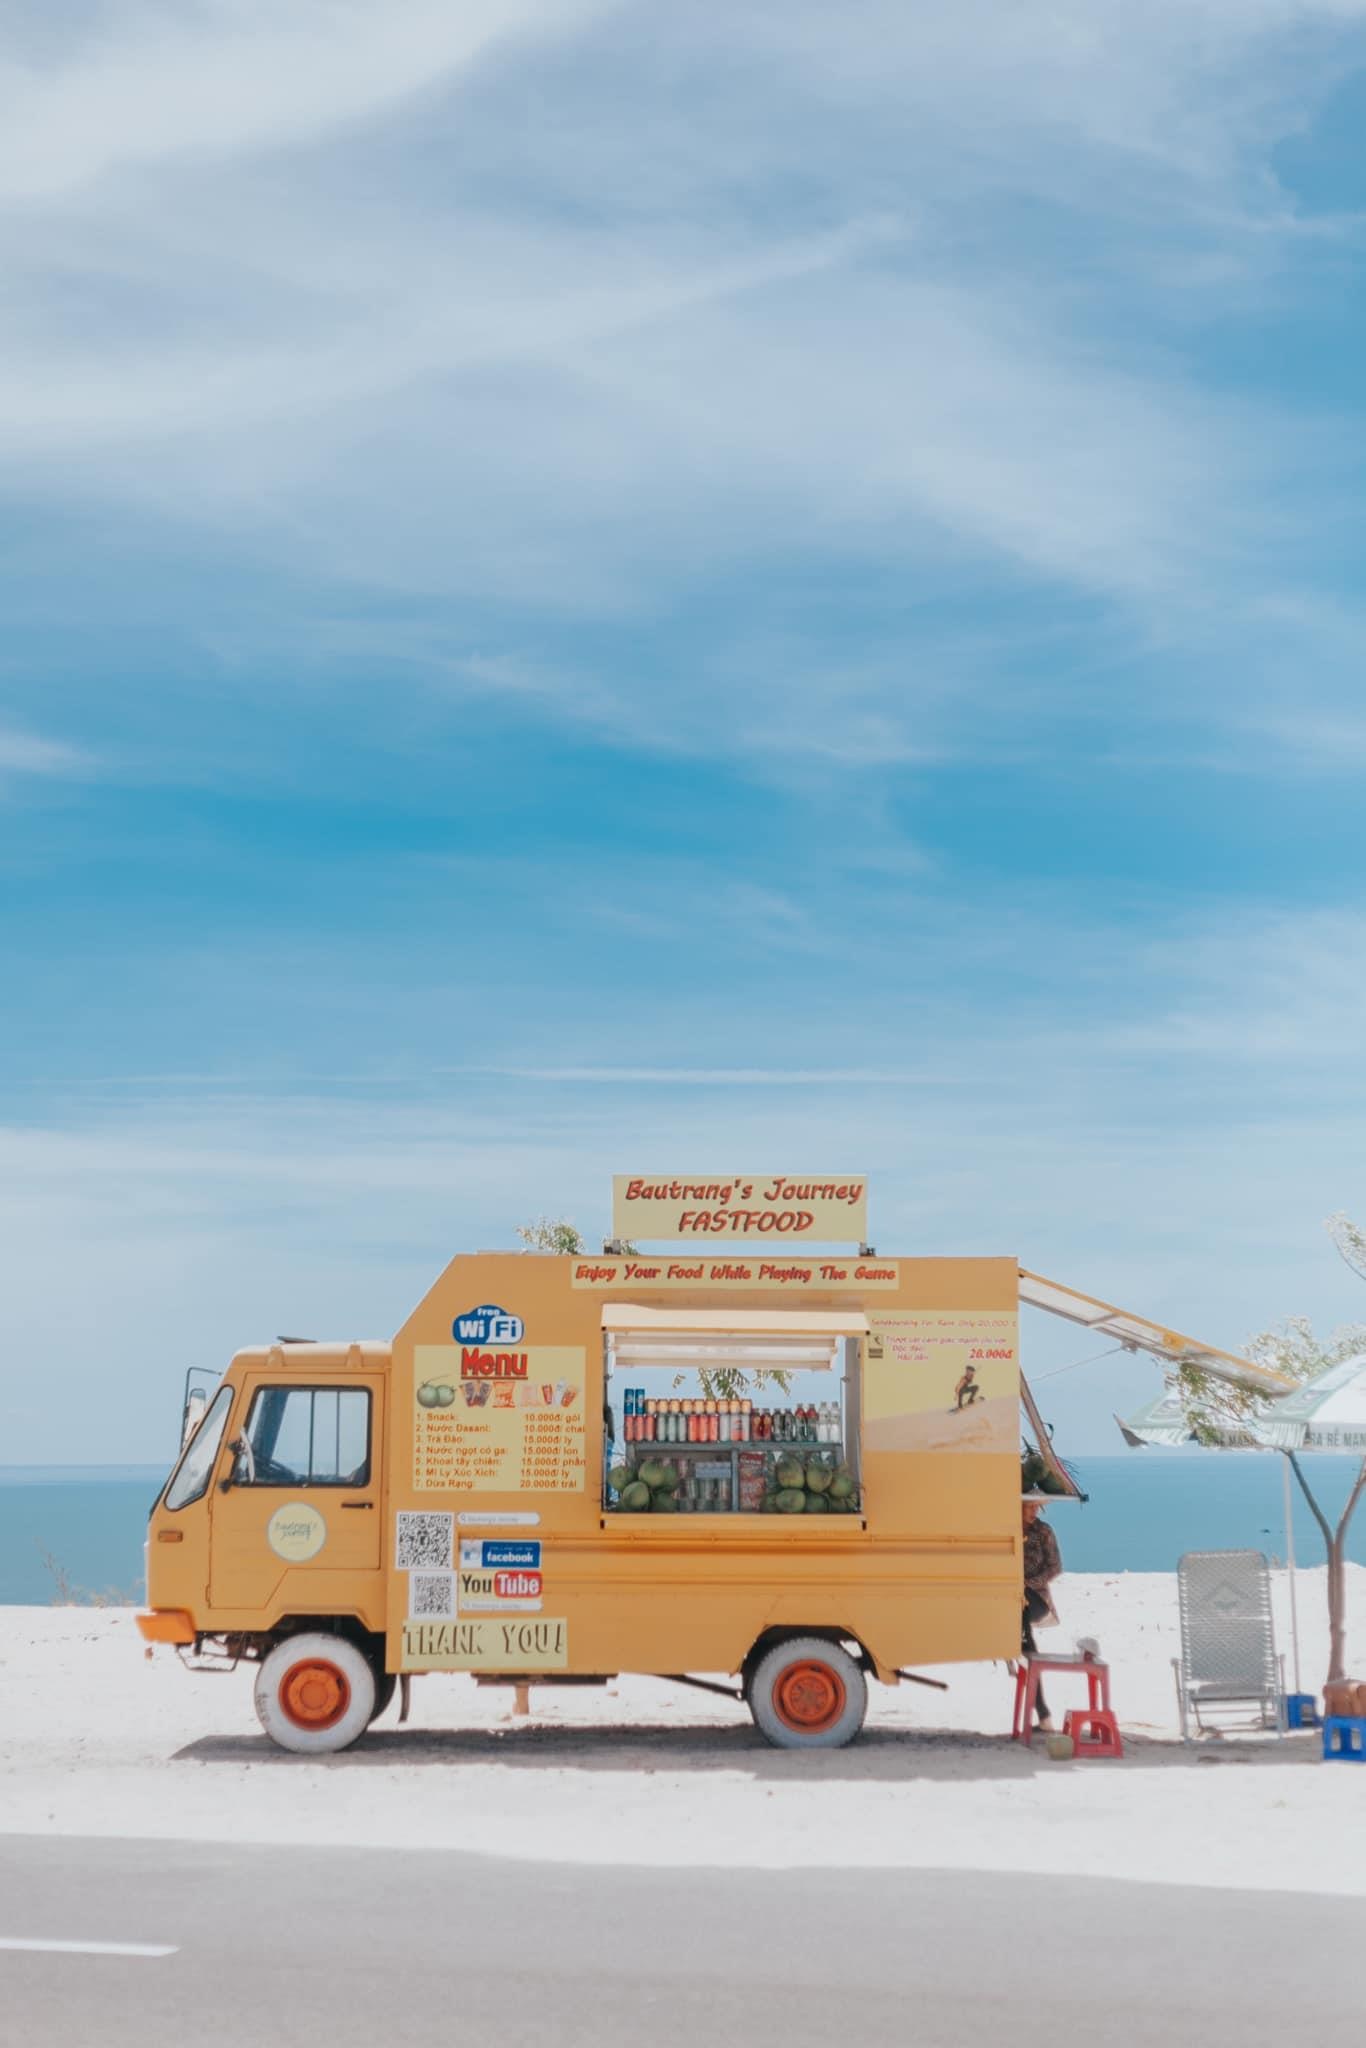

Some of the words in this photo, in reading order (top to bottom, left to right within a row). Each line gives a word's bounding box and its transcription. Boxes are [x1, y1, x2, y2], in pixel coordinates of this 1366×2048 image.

[625, 1179, 753, 1205] Bautrang's
[764, 1178, 863, 1205] Journey
[678, 1210, 814, 1233] FASTFOOD
[575, 1264, 616, 1282] Enjoy
[624, 1264, 661, 1280] Your
[667, 1264, 703, 1279] Food
[711, 1264, 752, 1280] While
[758, 1264, 811, 1283] Playing
[820, 1265, 847, 1280] The
[461, 1347, 528, 1376] Menu
[486, 1551, 533, 1563] facebook
[403, 1624, 484, 1656] THANK
[502, 1623, 564, 1655] YOU!
